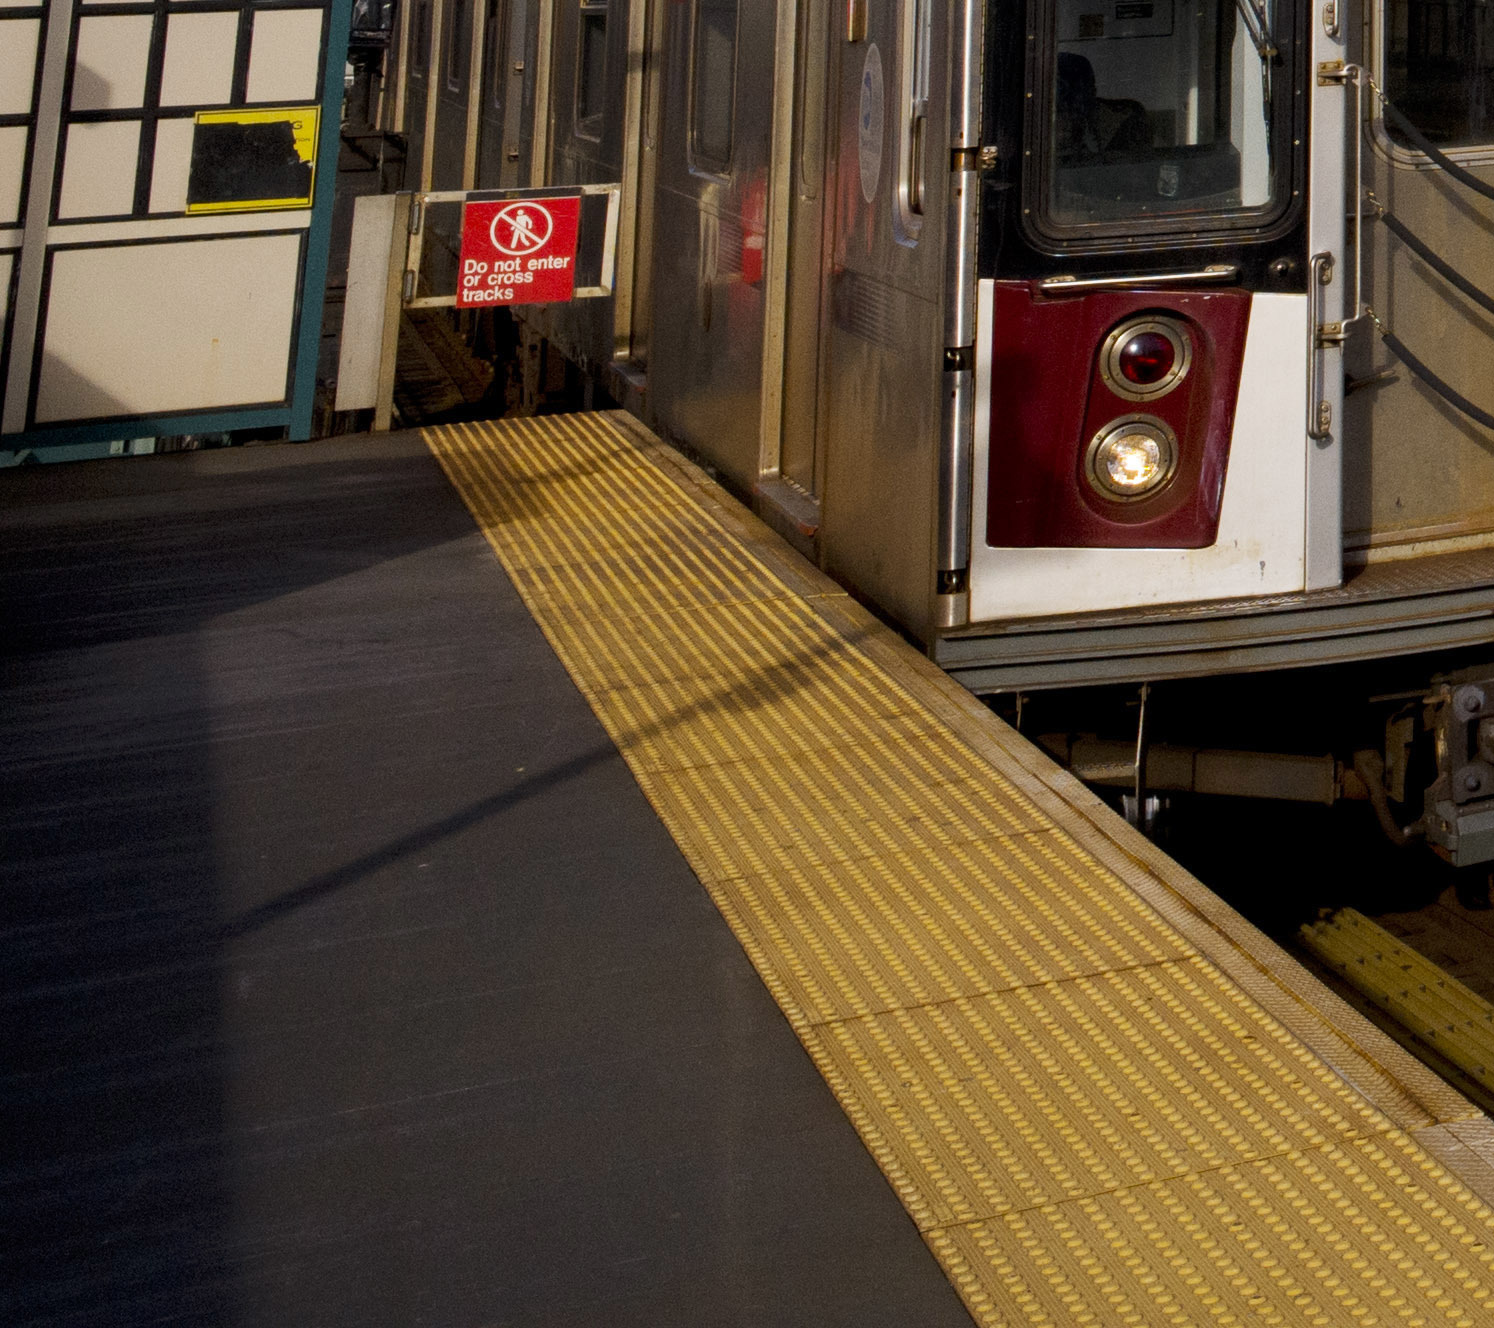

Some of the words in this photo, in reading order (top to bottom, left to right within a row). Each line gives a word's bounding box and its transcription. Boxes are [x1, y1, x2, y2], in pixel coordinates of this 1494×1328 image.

[464, 259, 488, 275] Do
[494, 257, 522, 272] not
[527, 255, 571, 270] enter
[463, 274, 482, 287] or
[487, 272, 534, 285] cross
[462, 285, 514, 302] tracks
